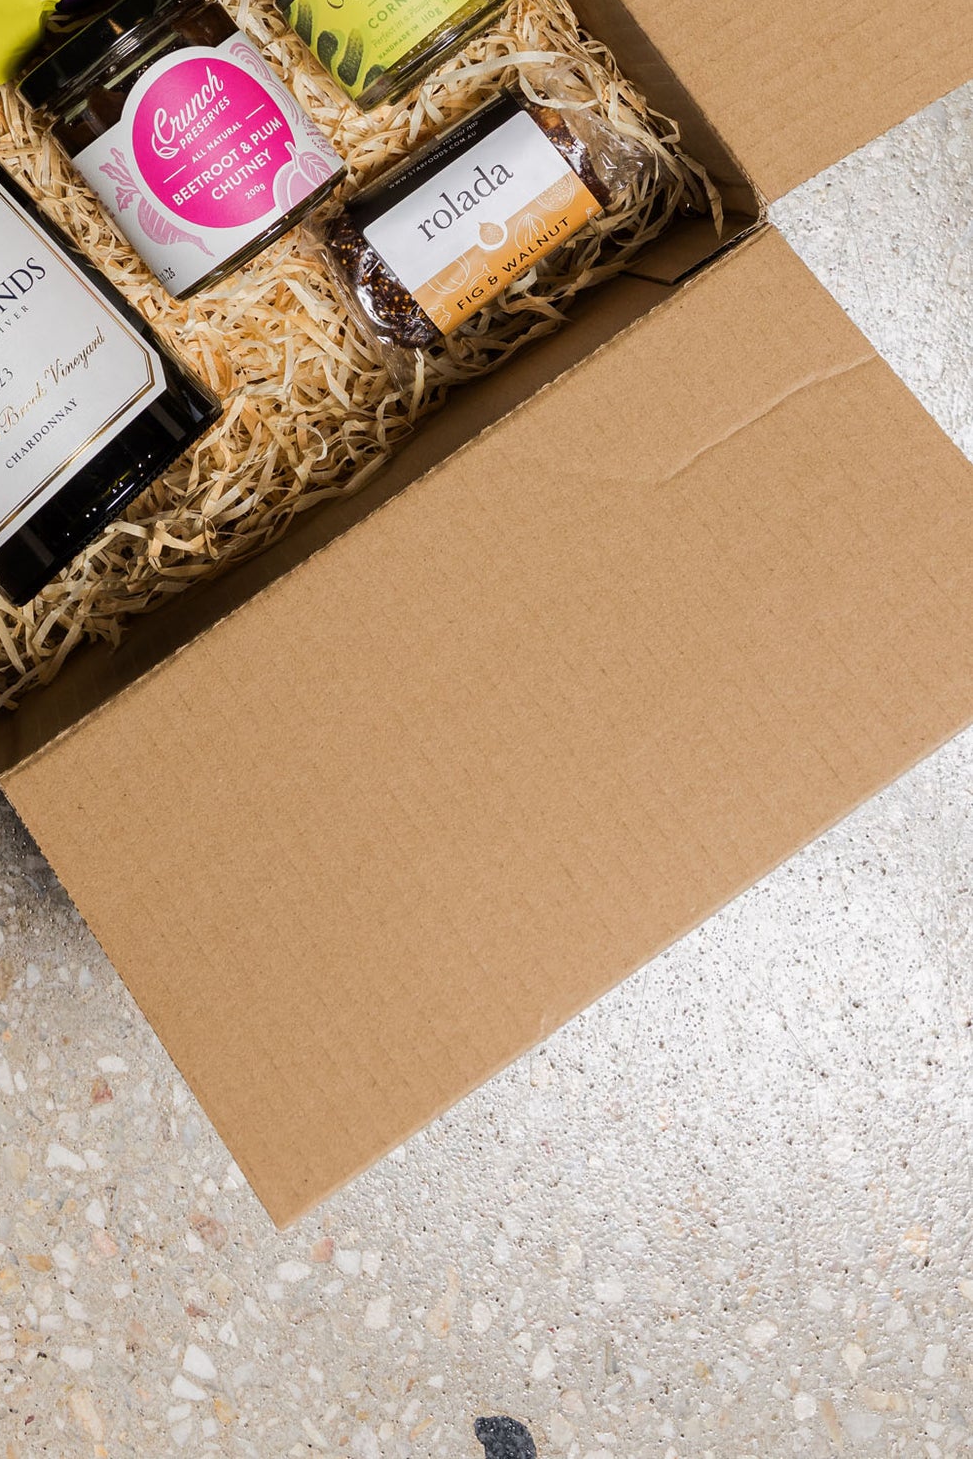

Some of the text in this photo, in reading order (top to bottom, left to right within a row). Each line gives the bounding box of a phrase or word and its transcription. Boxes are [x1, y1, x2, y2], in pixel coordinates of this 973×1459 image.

[151, 65, 224, 153] Crunch
[179, 95, 231, 150] PRESERVES
[191, 121, 243, 164] ALL NATURAL
[171, 116, 283, 207] BEETROOT & PLUM
[210, 147, 274, 202] CHUTNEY
[244, 182, 266, 200] 200g
[416, 160, 514, 243] rolada
[456, 215, 570, 311] FIG & WALNUT
[44, 324, 106, 386] Vineyard
[4, 396, 80, 471] CHARDONNAY
